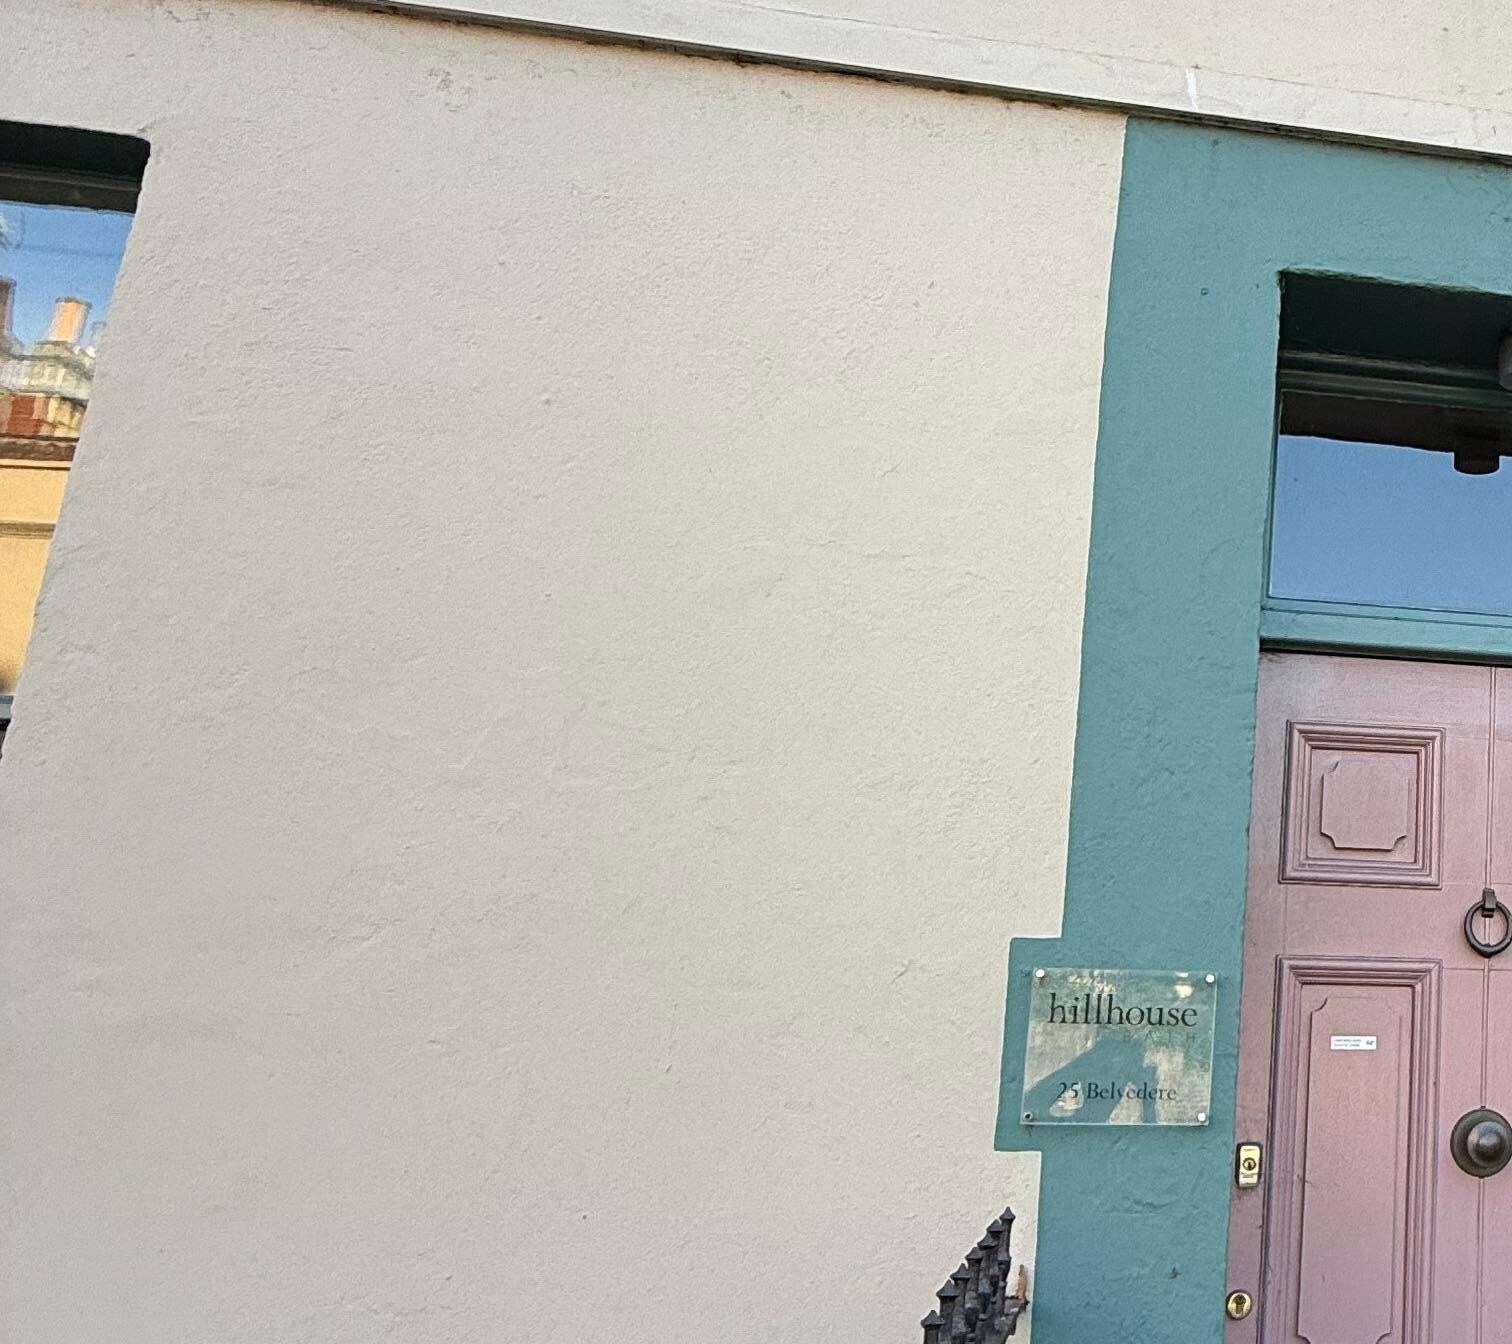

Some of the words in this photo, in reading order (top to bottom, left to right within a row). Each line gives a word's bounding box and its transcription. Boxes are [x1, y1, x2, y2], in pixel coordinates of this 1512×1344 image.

[1047, 992, 1199, 1027] hillhouse
[1056, 1081, 1080, 1099] 25
[1086, 1081, 1178, 1100] Belvedere
